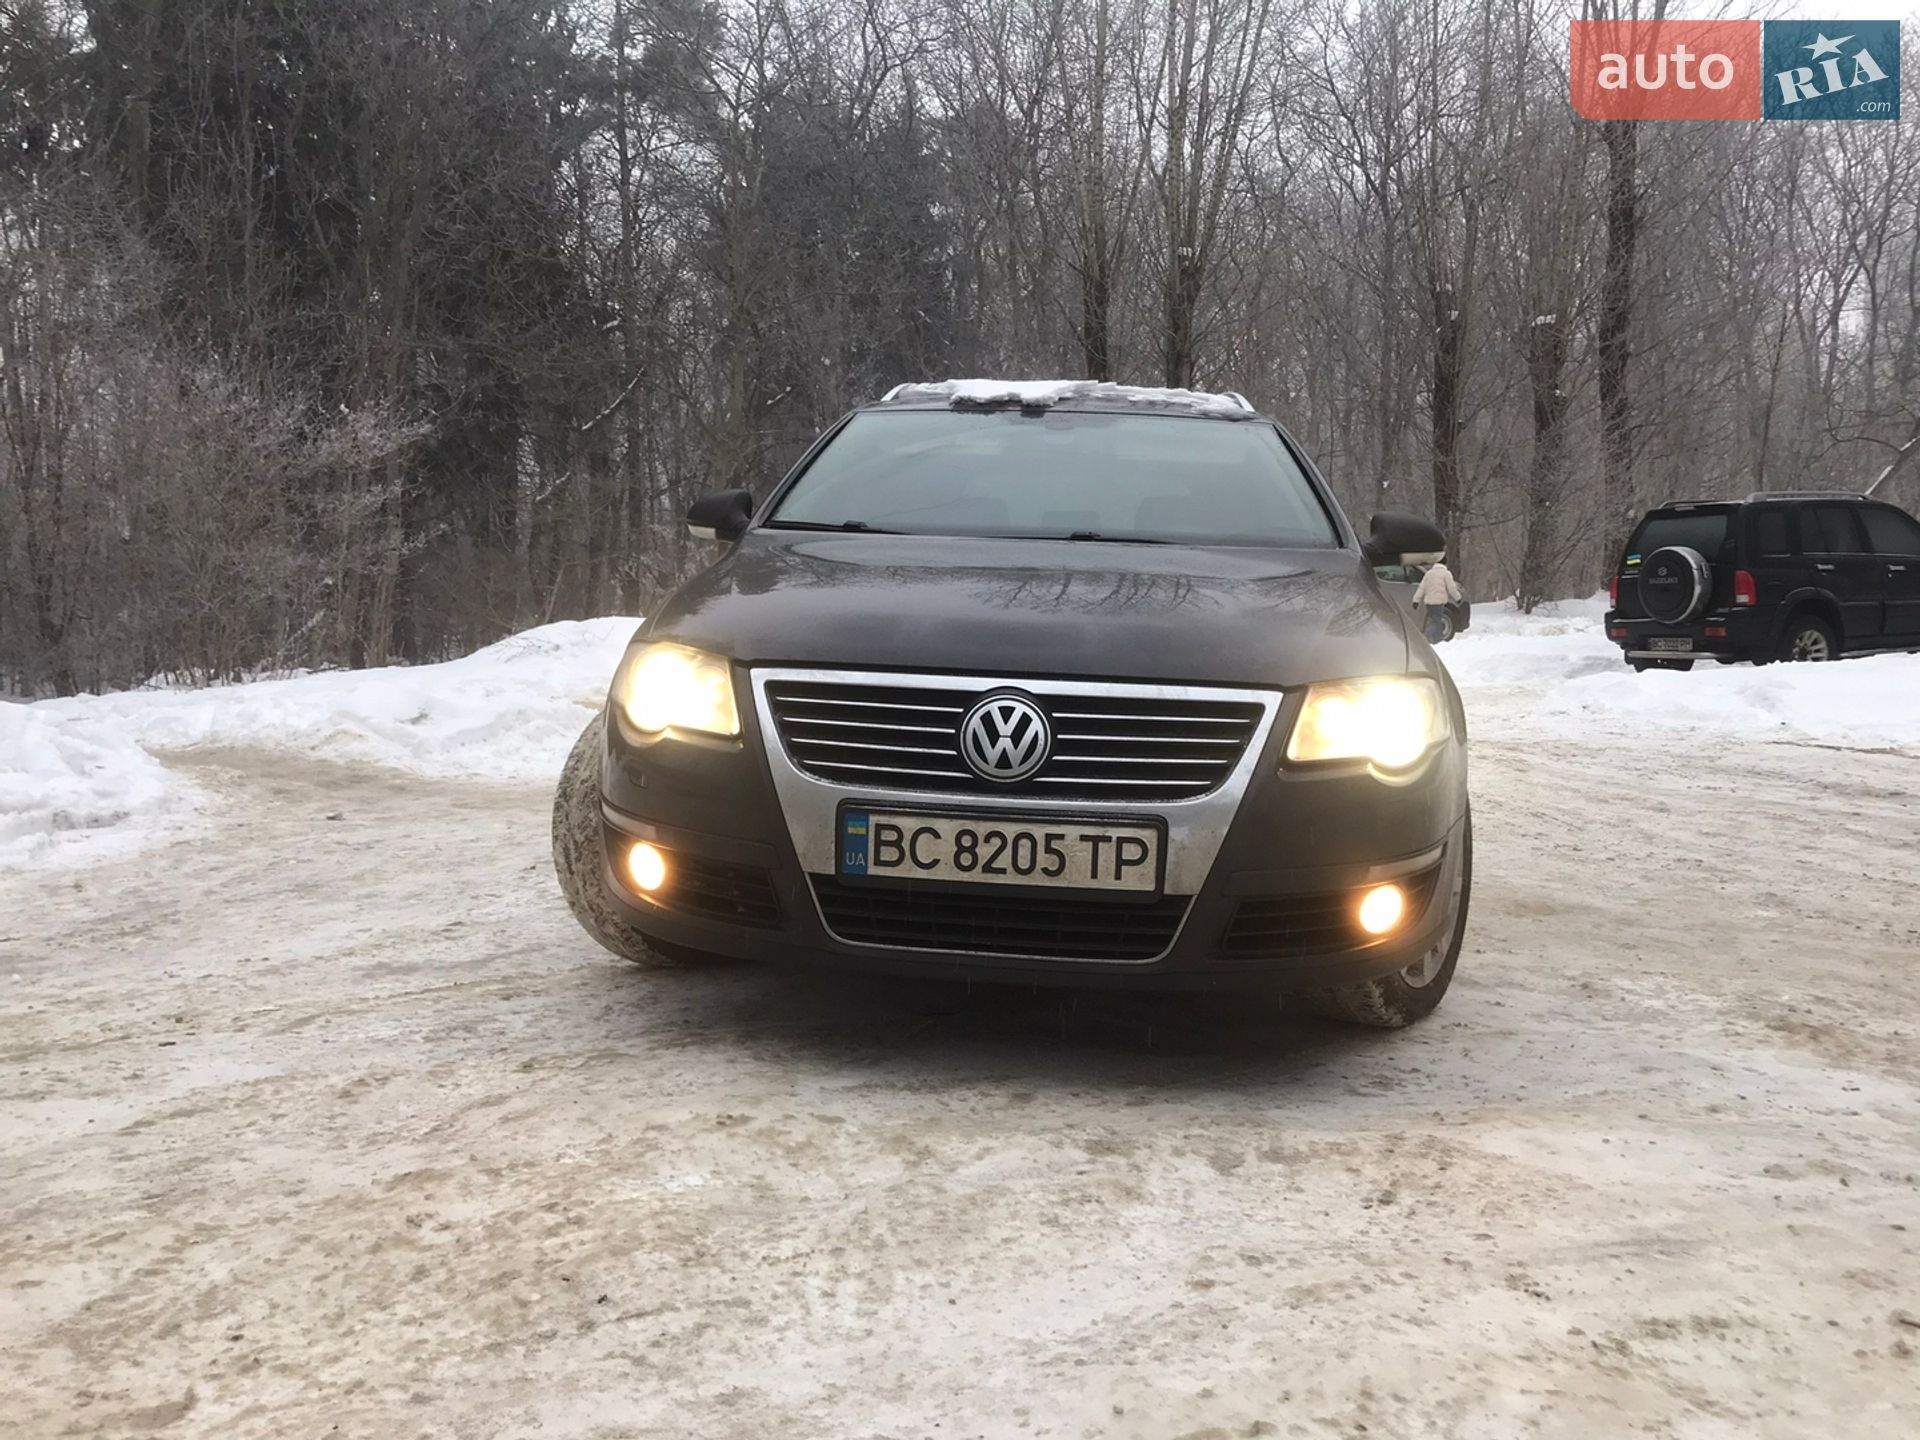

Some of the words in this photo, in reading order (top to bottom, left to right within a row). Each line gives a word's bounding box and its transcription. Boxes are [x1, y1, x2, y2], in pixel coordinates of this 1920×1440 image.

[845, 851, 866, 867] UA
[872, 822, 942, 871] BC
[952, 828, 1067, 878] 8205
[1078, 833, 1150, 881] TP
